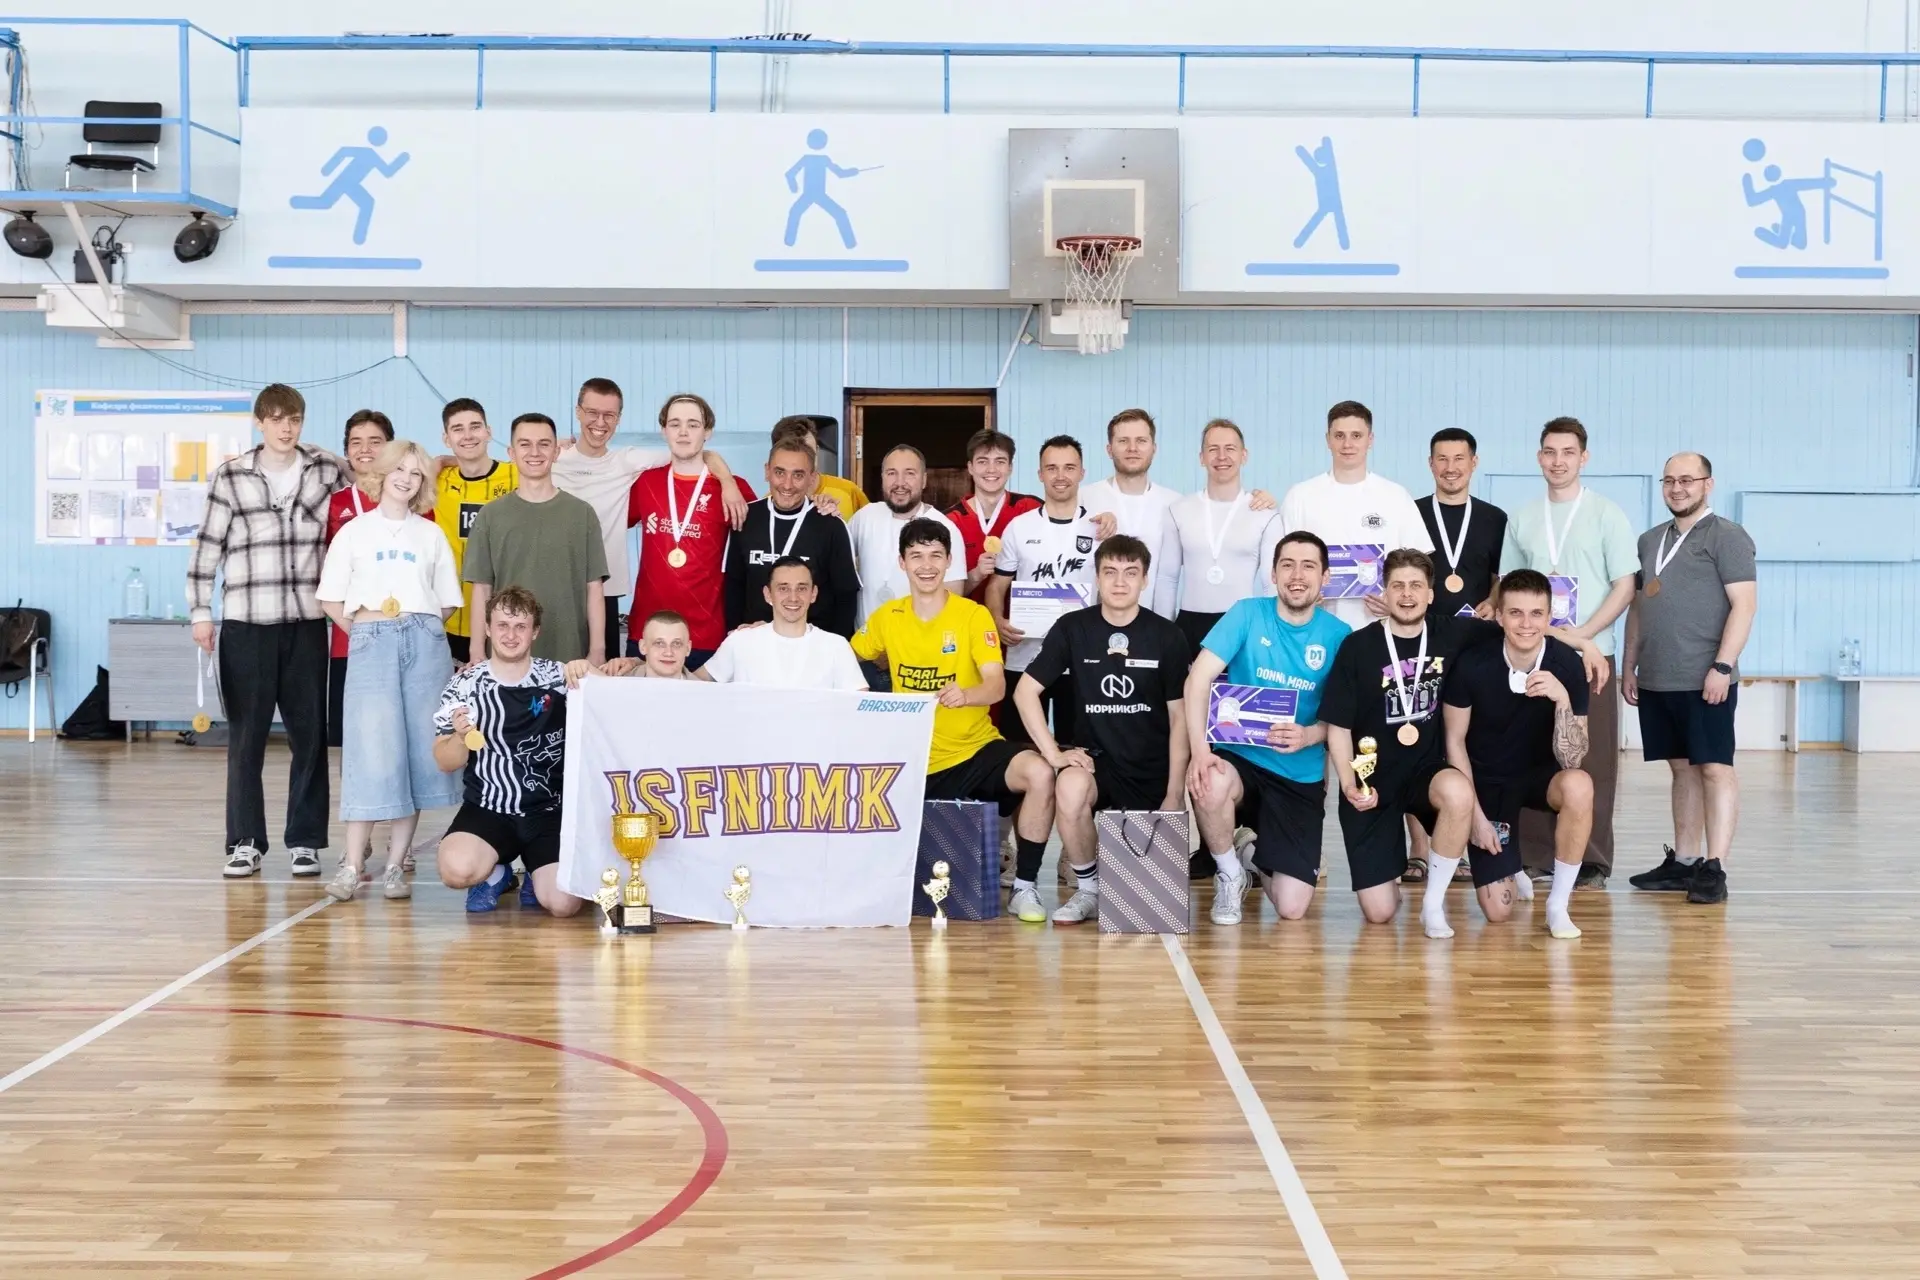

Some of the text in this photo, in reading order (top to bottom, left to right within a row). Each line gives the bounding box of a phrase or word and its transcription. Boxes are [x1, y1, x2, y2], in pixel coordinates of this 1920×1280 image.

[900, 666, 937, 680] PARI
[1287, 675, 1317, 692] MARA
[856, 699, 929, 713] BARSSPORT
[1085, 703, 1152, 714] НОРНИКЕЛЬ
